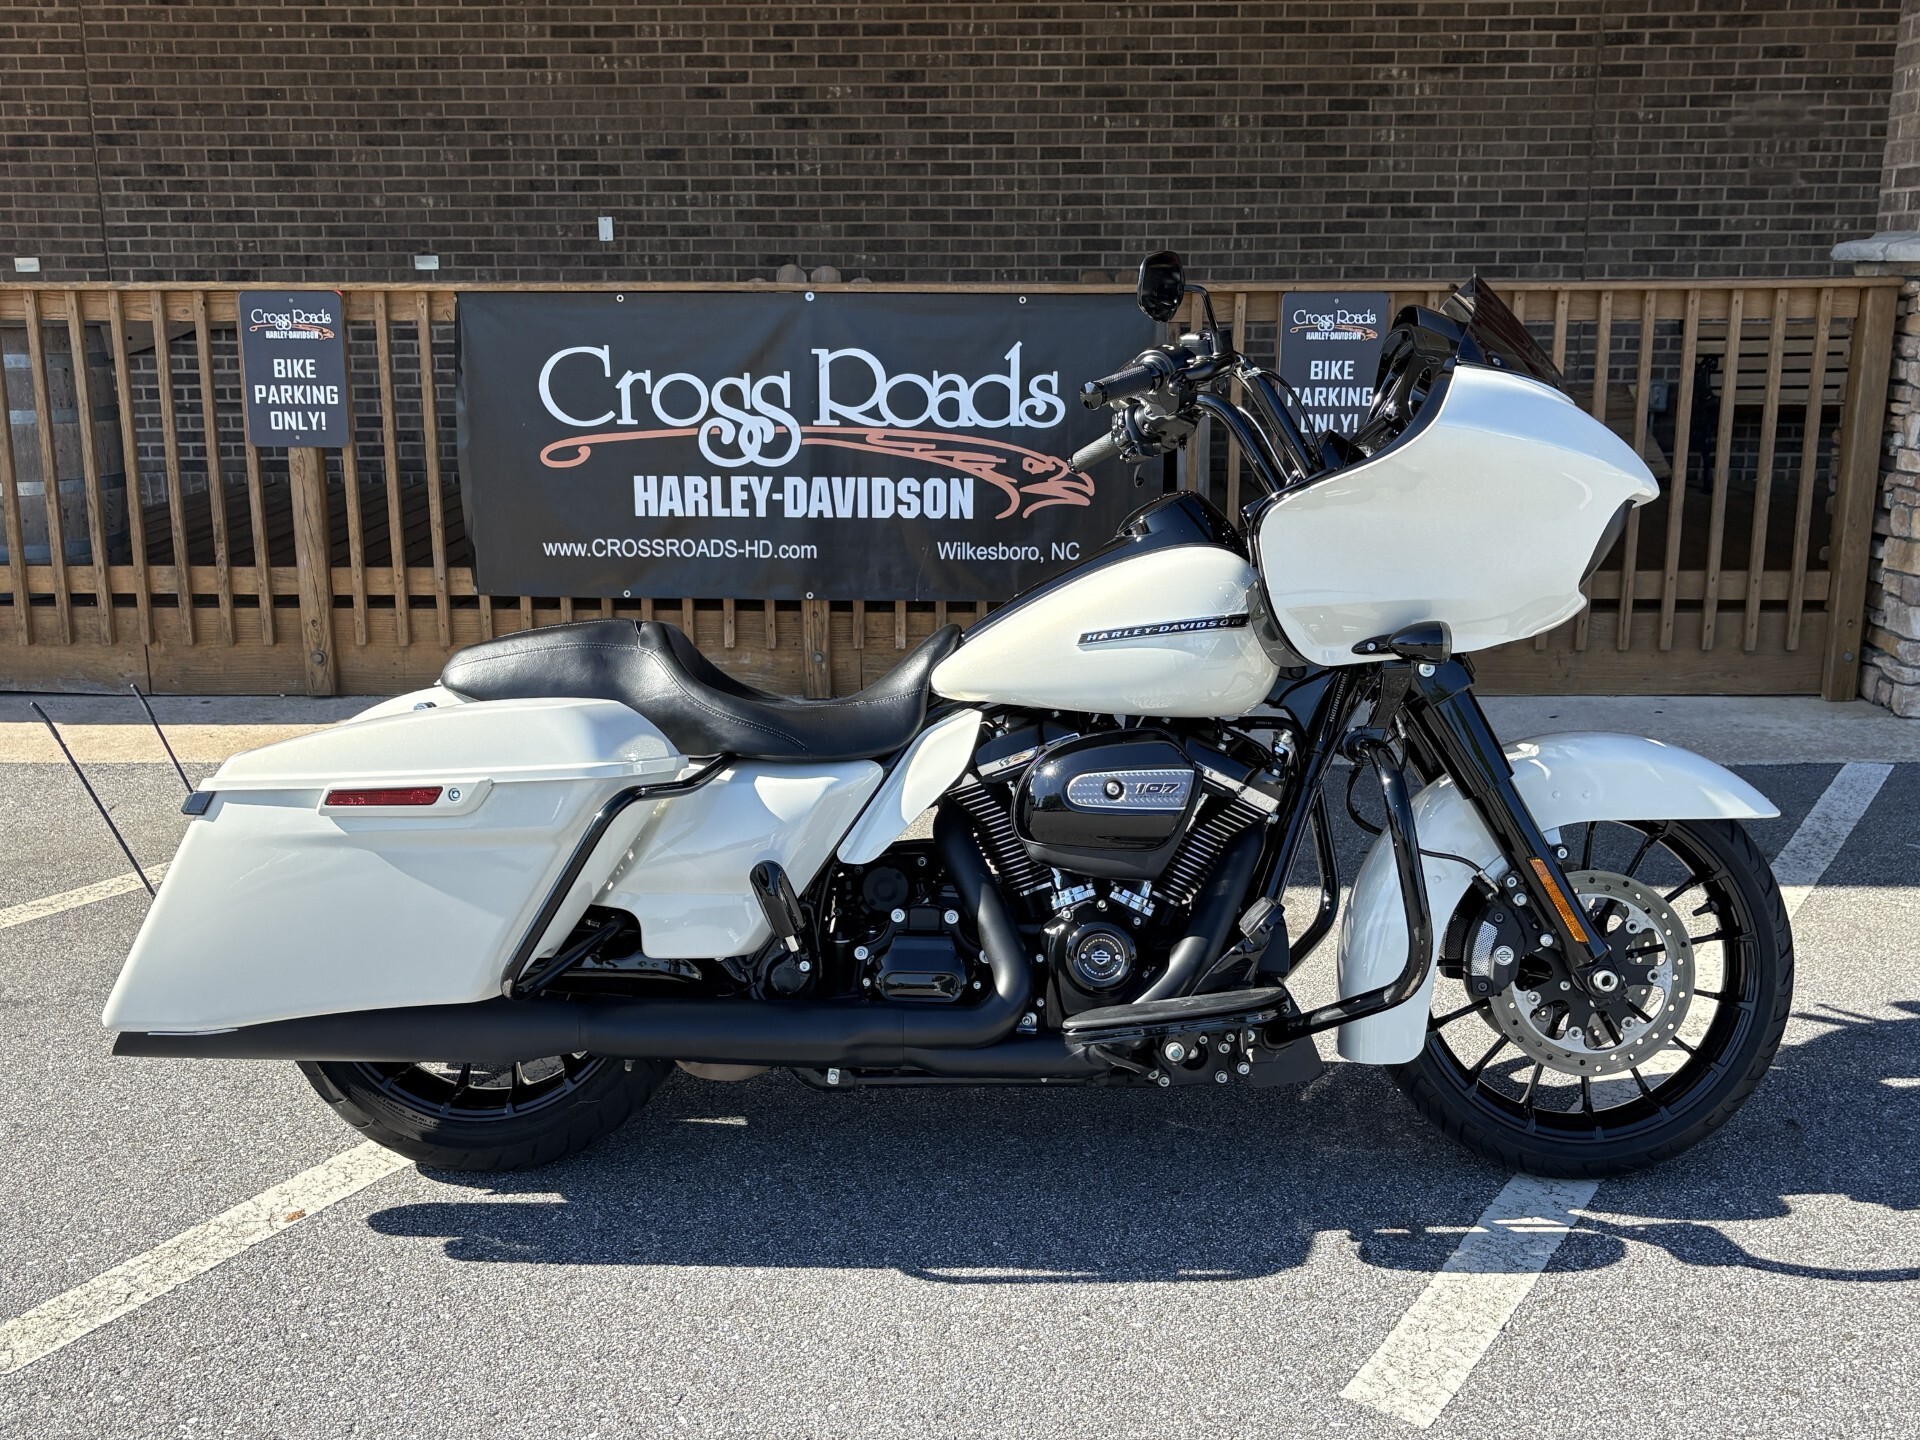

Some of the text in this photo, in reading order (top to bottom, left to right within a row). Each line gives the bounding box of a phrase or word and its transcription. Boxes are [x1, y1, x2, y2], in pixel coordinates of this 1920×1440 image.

[251, 308, 332, 330] Cross Roads
[1293, 308, 1377, 332] Cross Roads
[265, 330, 319, 339] HARLEY-DAVIDSON
[1306, 331, 1361, 340] HARLEY-DAVIDSON
[272, 358, 317, 379] BIKE
[1309, 360, 1355, 380] BIKE
[254, 384, 339, 405] PARKING
[538, 340, 1066, 468] Cross Roads
[270, 410, 327, 431] ONLY!
[633, 475, 974, 520] HARLEY-DAVIDSON
[542, 538, 818, 559] www.CROSSROADS-HD.com
[937, 541, 1080, 563] Wilkesboro, NC
[1085, 617, 1242, 642] HARLEY-DAVIDSON
[1135, 782, 1180, 795] 107
